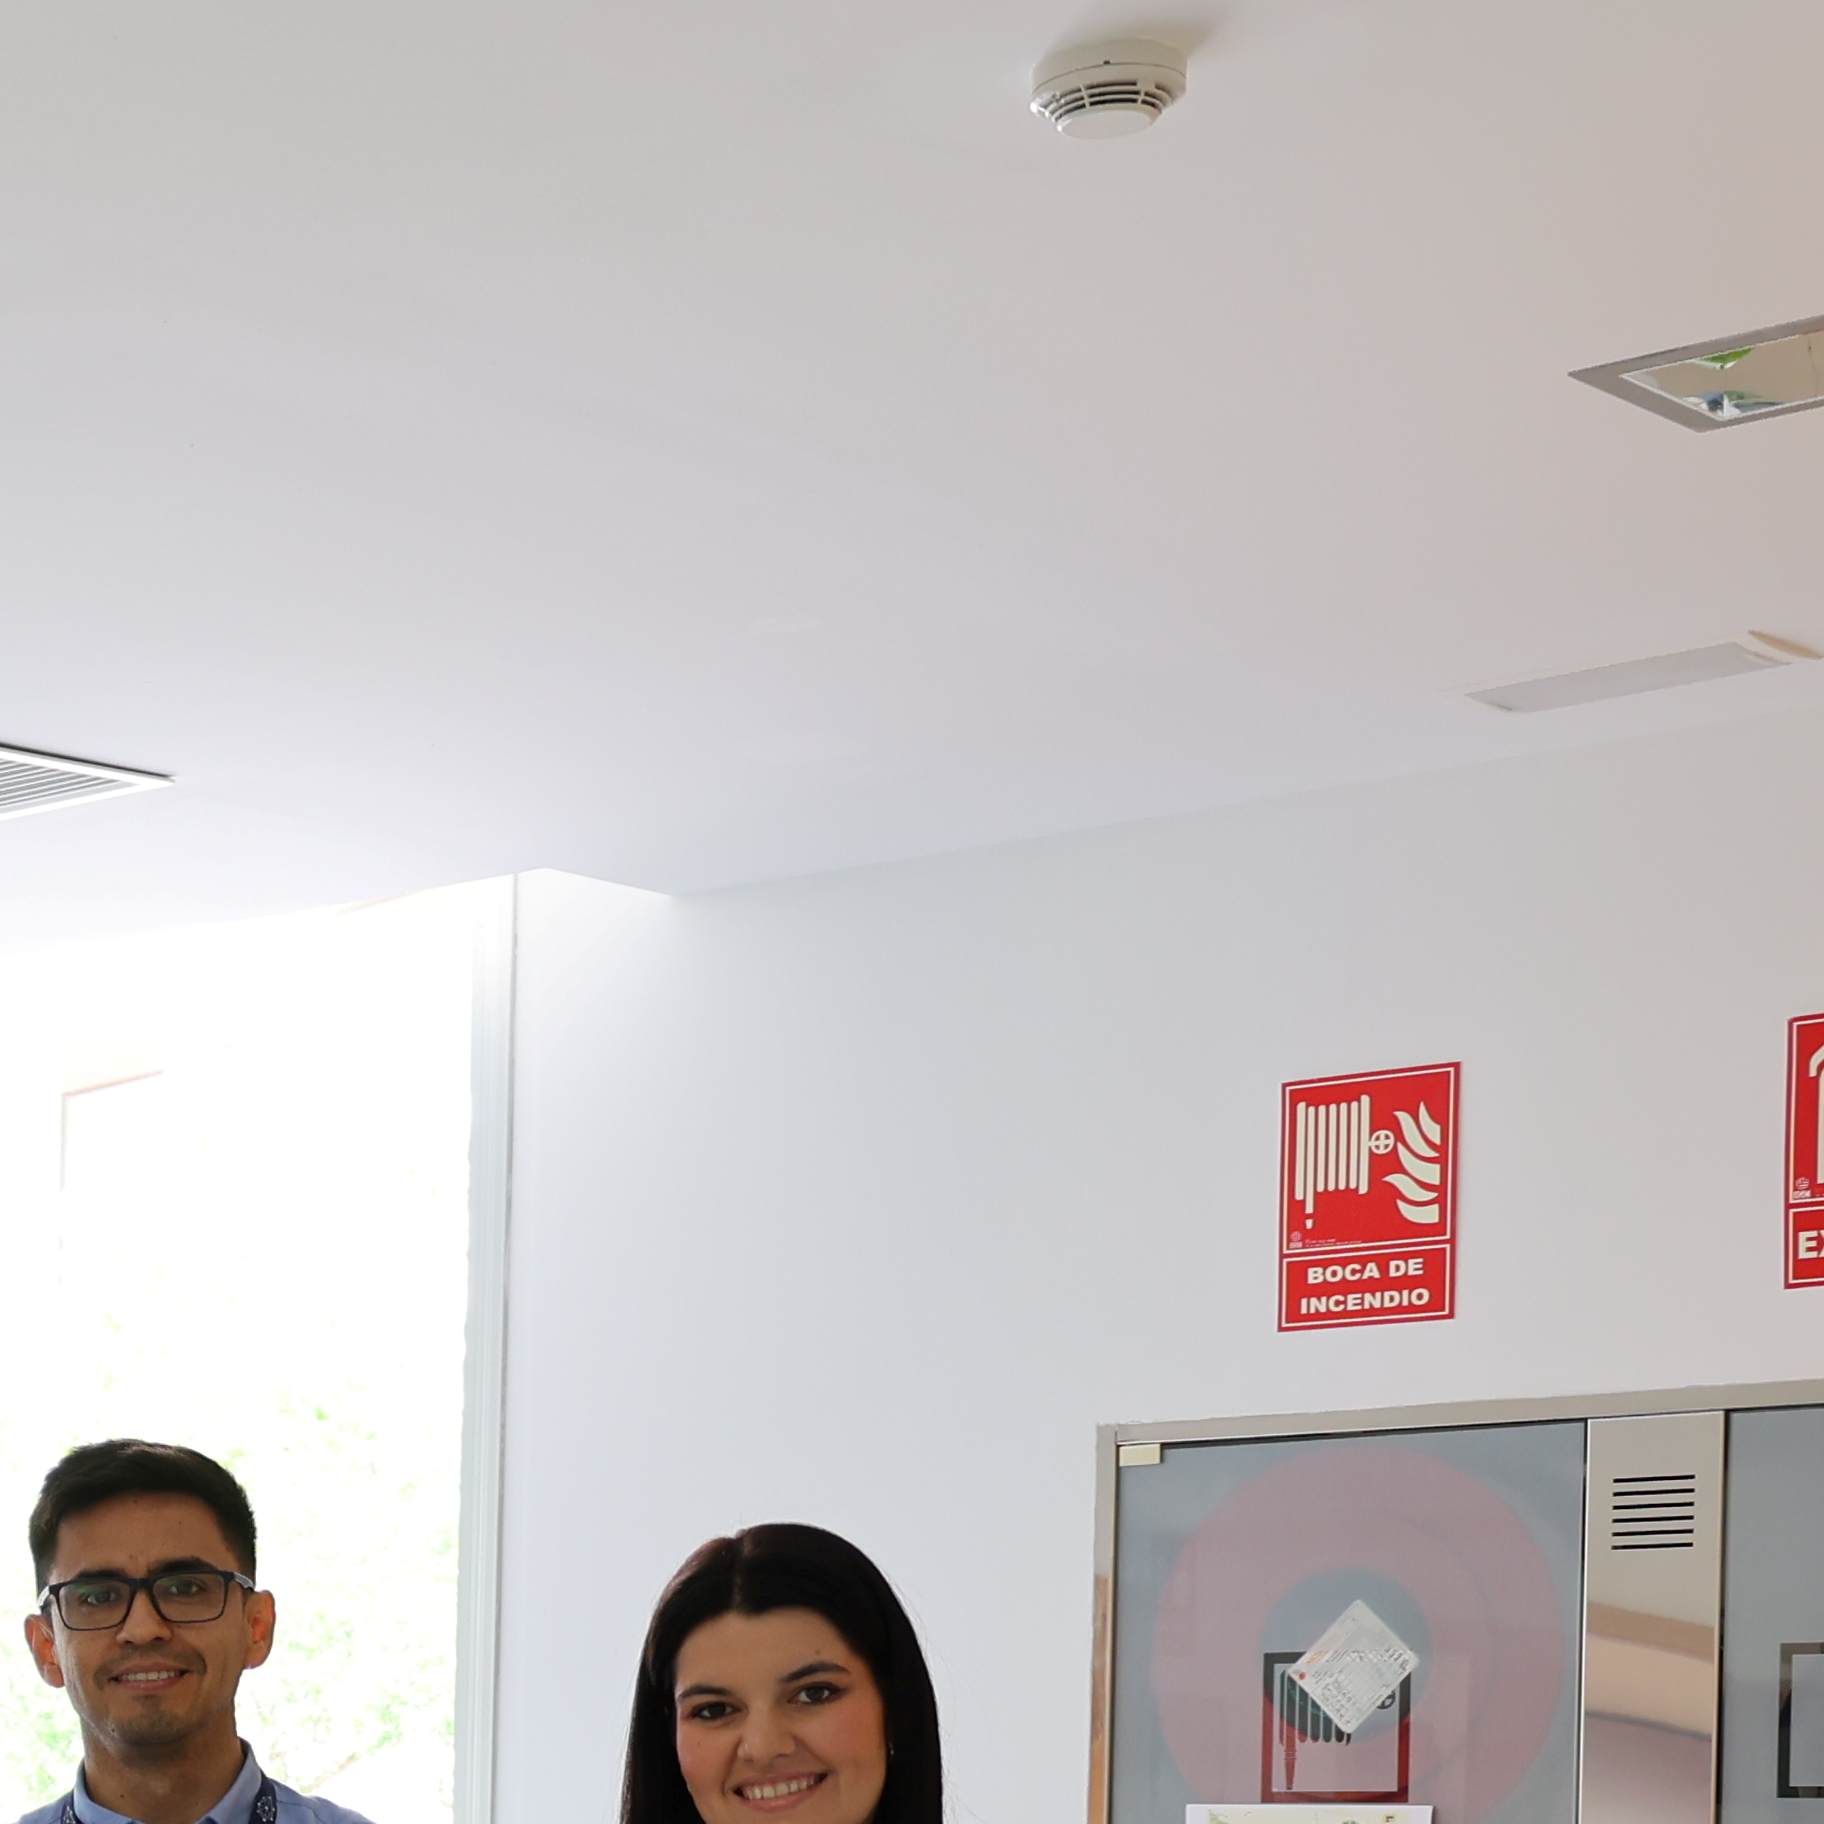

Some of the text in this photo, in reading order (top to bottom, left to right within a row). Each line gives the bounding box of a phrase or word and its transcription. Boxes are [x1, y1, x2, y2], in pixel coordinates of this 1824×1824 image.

[1307, 1258, 1424, 1284] BOCA DE
[1300, 1288, 1430, 1314] INCENDIO
